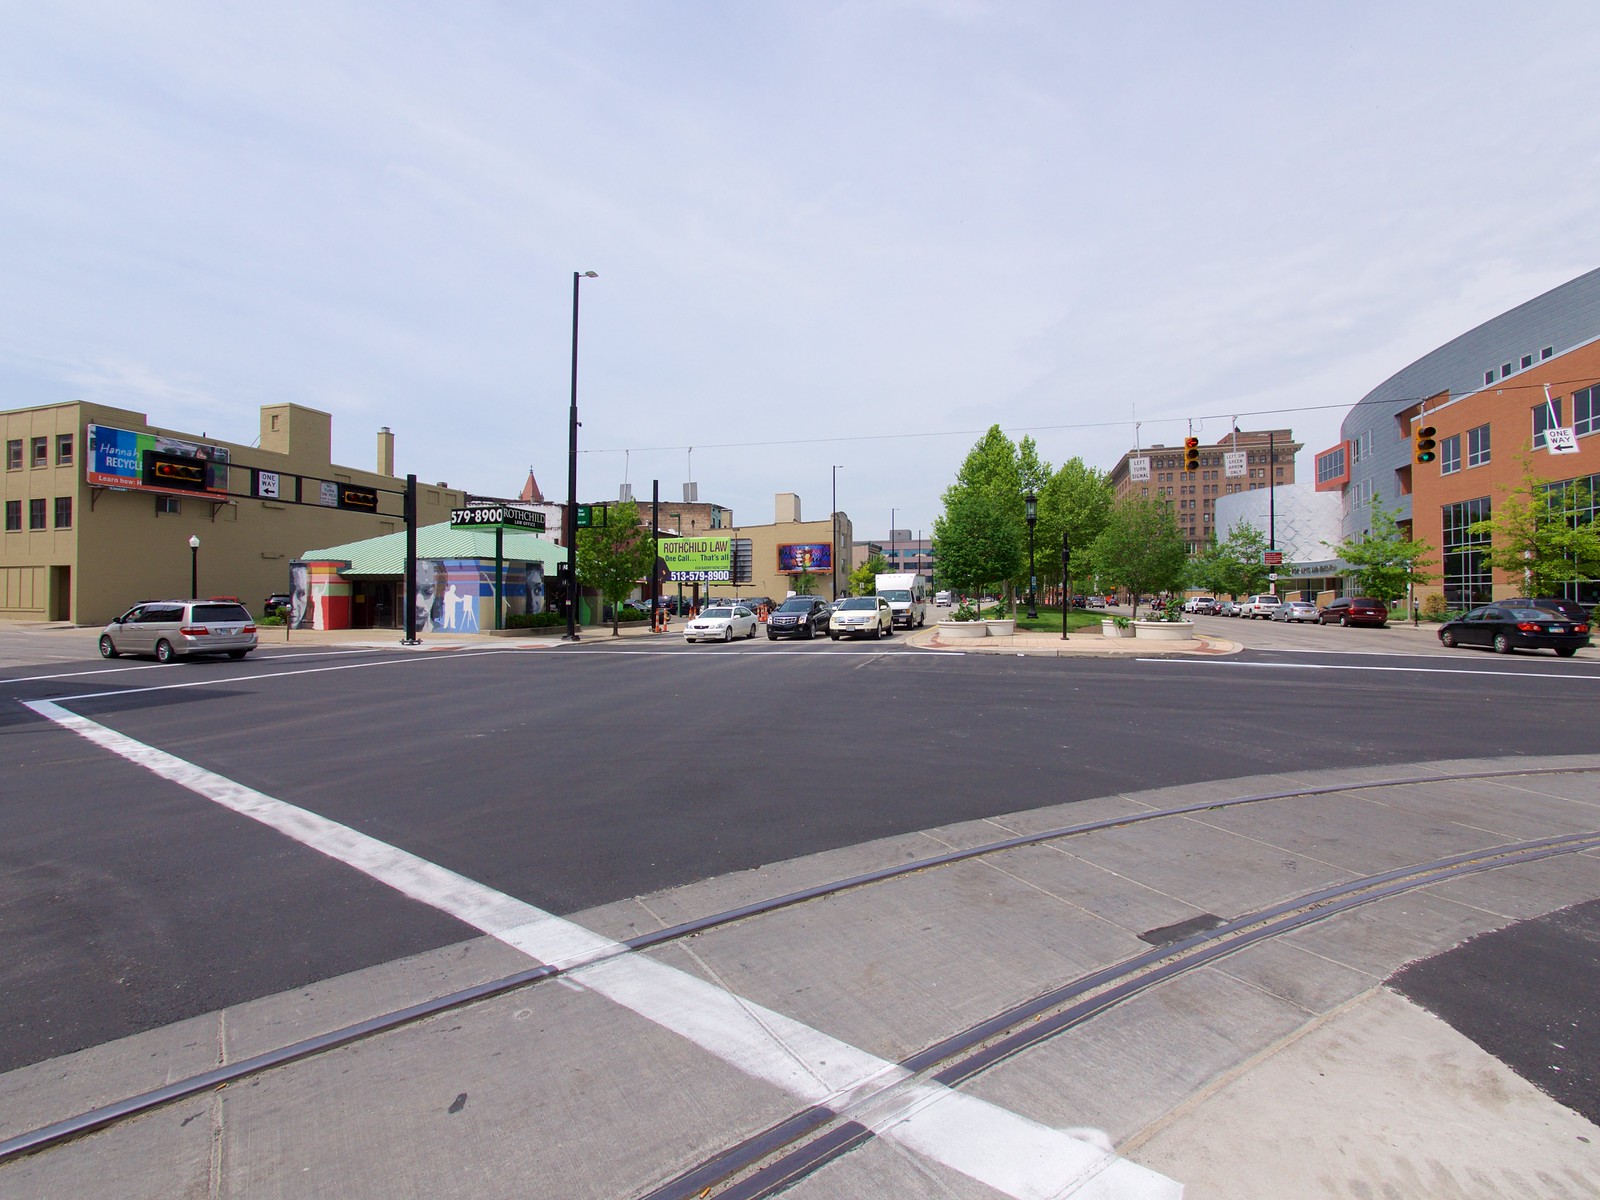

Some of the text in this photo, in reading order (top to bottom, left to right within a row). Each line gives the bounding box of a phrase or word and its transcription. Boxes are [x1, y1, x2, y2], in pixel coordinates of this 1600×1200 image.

[1549, 430, 1570, 438] ONE
[1550, 436, 1570, 444] WAY
[100, 443, 140, 458] Hannah
[98, 475, 119, 484] Learn
[119, 477, 135, 486] how:
[261, 473, 276, 482] ONE
[261, 480, 277, 488] WAY
[451, 508, 503, 524] 579-8900
[503, 507, 546, 524] ROTHCHILD
[663, 540, 728, 554] ROTHCHILD LAW
[665, 553, 729, 562] One Call... That's all
[670, 570, 729, 581] 513-579-8900
